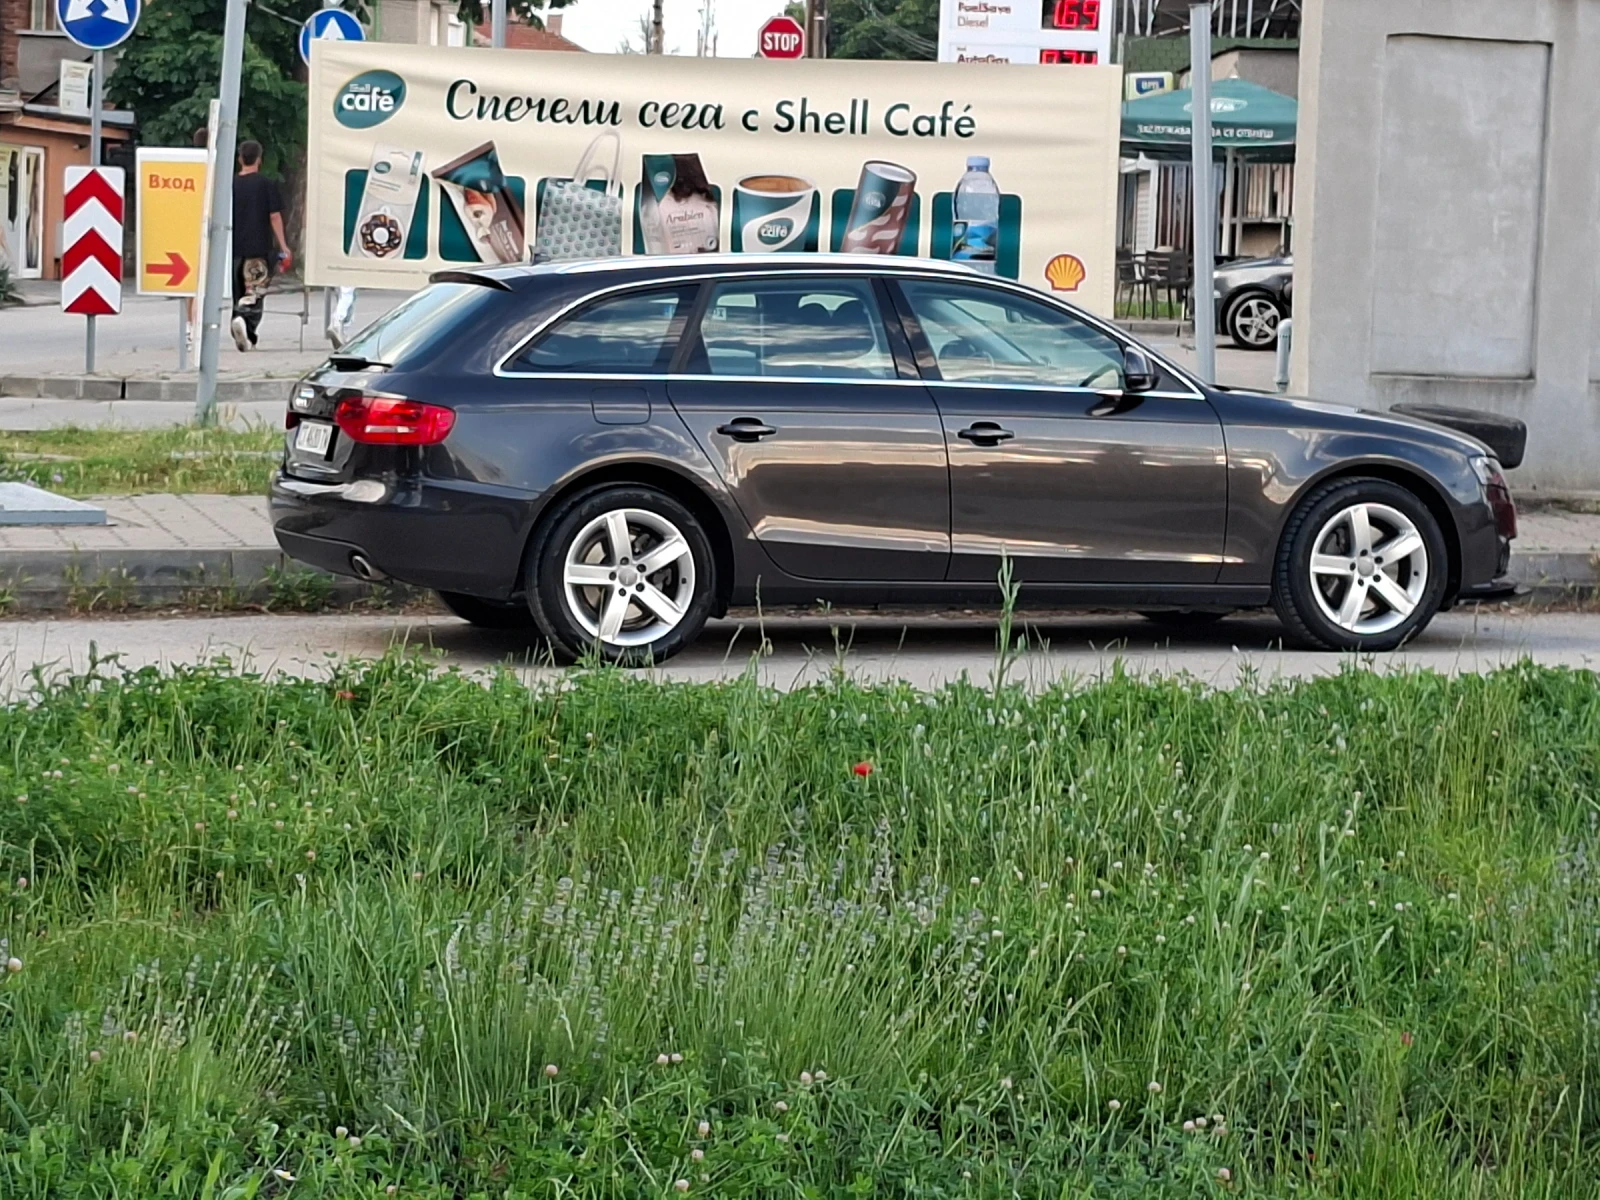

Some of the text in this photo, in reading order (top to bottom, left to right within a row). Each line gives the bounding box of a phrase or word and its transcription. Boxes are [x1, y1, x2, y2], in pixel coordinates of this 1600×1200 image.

[957, 15, 989, 27] Diesel
[763, 32, 800, 52] STOP
[342, 87, 394, 112] café
[445, 79, 976, 138] Спечели сега с Shell Café
[149, 174, 196, 192] Вход
